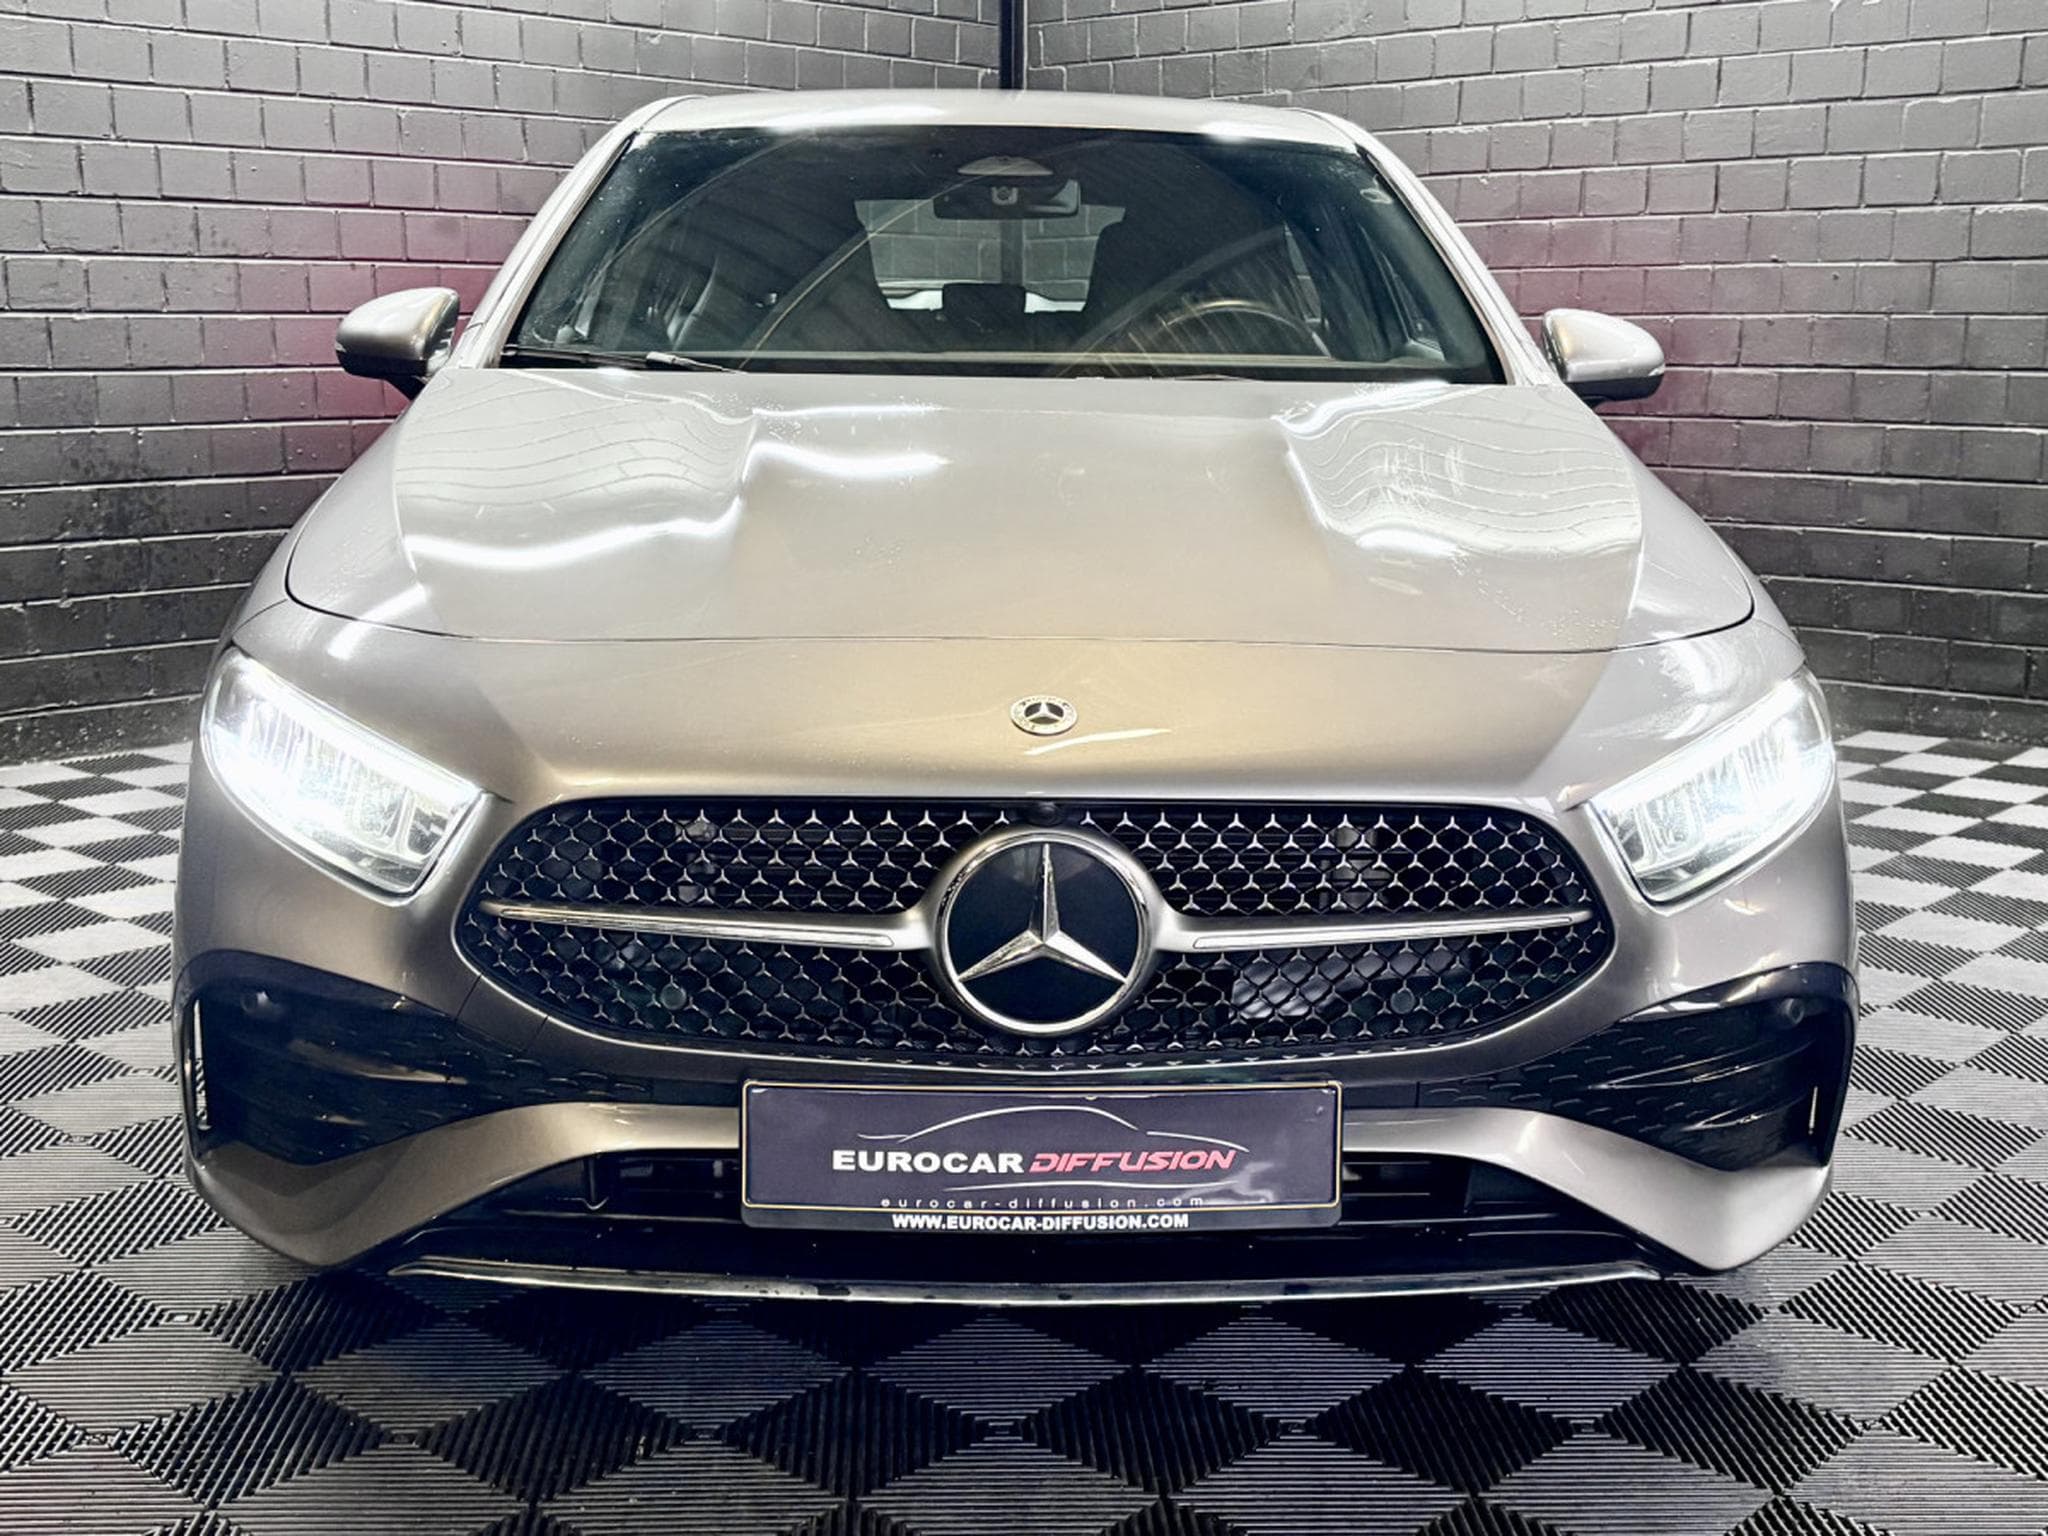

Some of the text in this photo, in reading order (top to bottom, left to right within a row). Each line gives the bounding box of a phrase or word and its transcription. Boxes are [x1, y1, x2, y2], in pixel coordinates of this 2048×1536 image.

[832, 1149, 1236, 1173] EUROCAR DIFFUSION
[892, 1213, 1189, 1231] WWW.EUROCAR-DIFFUSION.COM
